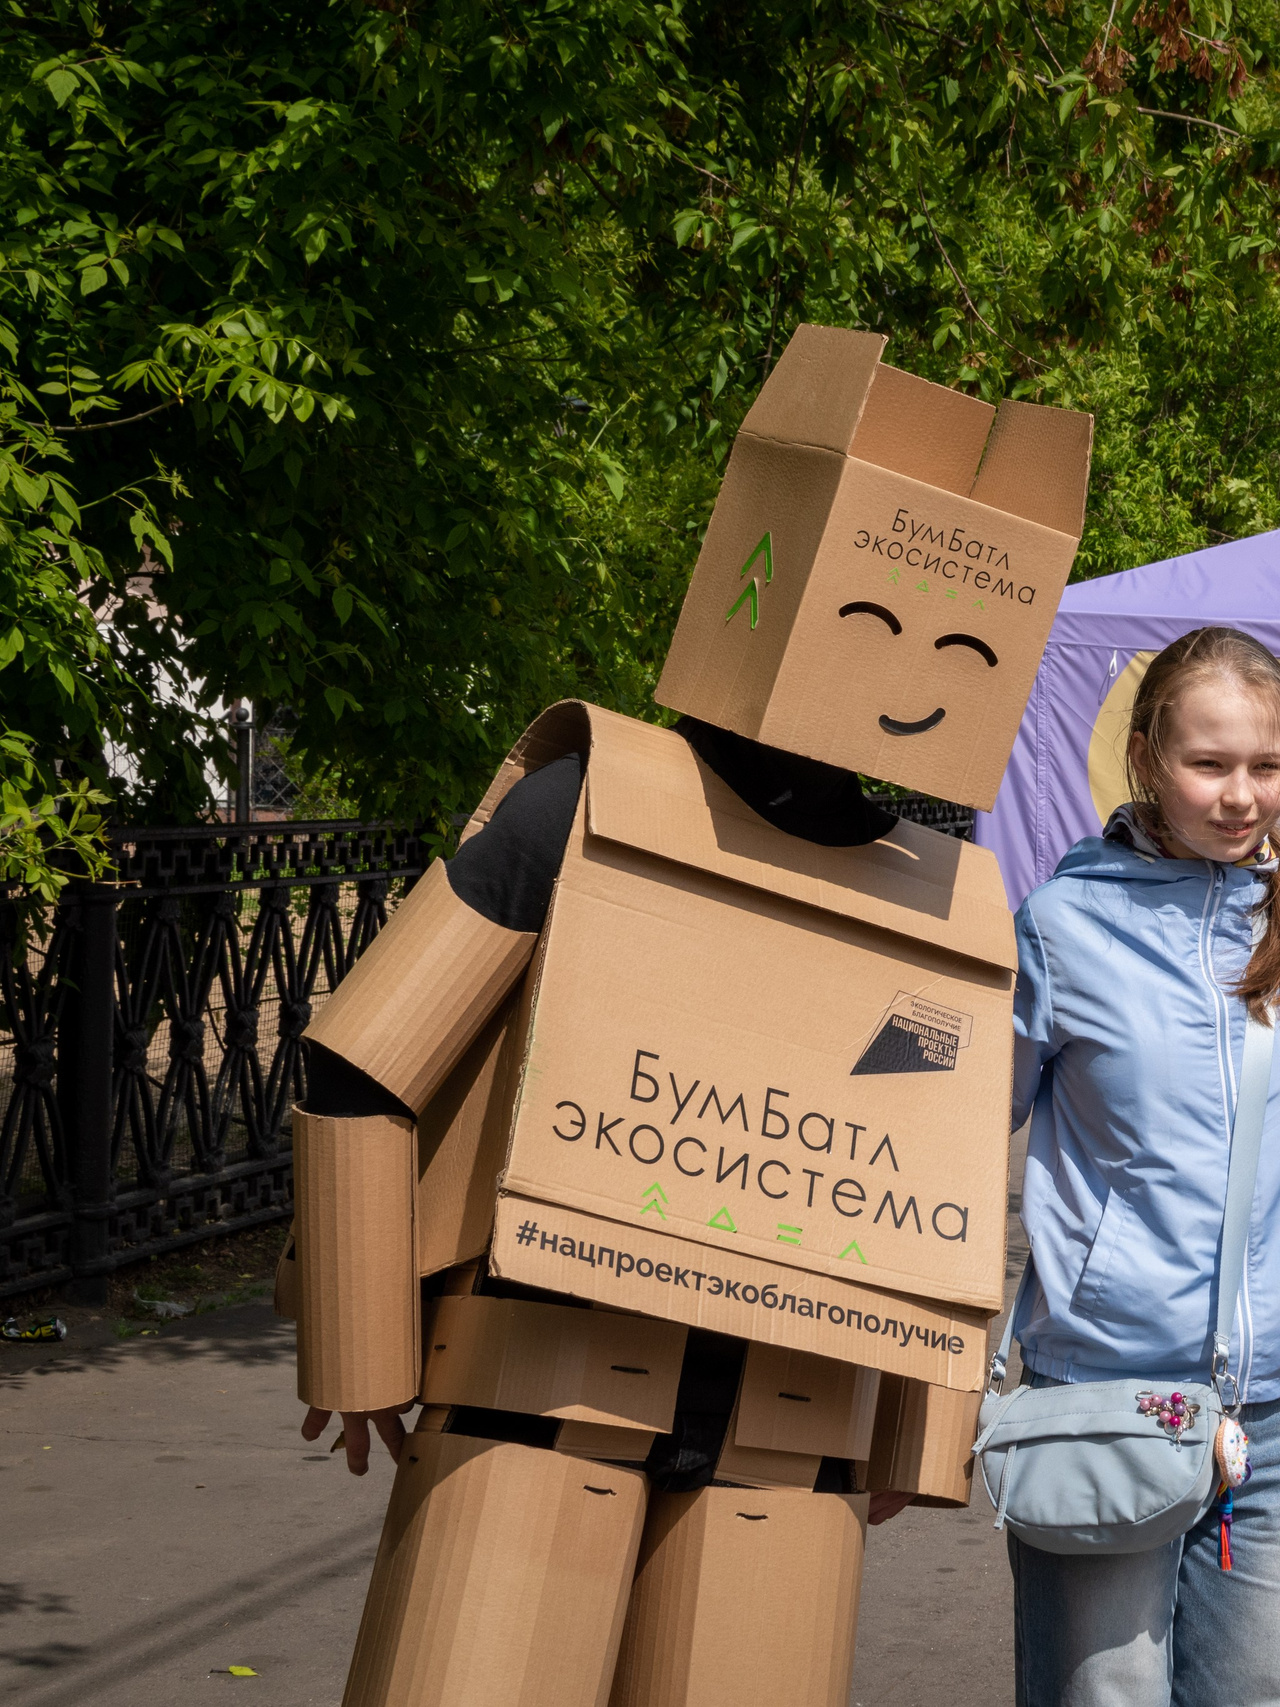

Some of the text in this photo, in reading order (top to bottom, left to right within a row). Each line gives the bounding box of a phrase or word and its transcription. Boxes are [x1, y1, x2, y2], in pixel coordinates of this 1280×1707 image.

[891, 508, 1010, 570] БумБатл
[853, 530, 1037, 606] экосистема
[892, 1016, 958, 1047] НАЦИОНАЛЬНЫЕ
[910, 1001, 963, 1023] ЭКОЛОГИЧЕСКОЕ
[912, 1010, 961, 1032] БЛАГОПОЛУЧИЕ
[918, 1036, 957, 1058] ПРОЕКТЫ
[923, 1049, 955, 1069] РОССИИ
[630, 1049, 900, 1172] БумБатл
[552, 1101, 969, 1242] экосистема
[515, 1220, 965, 1355] #нацпроектэкоблагополучие
